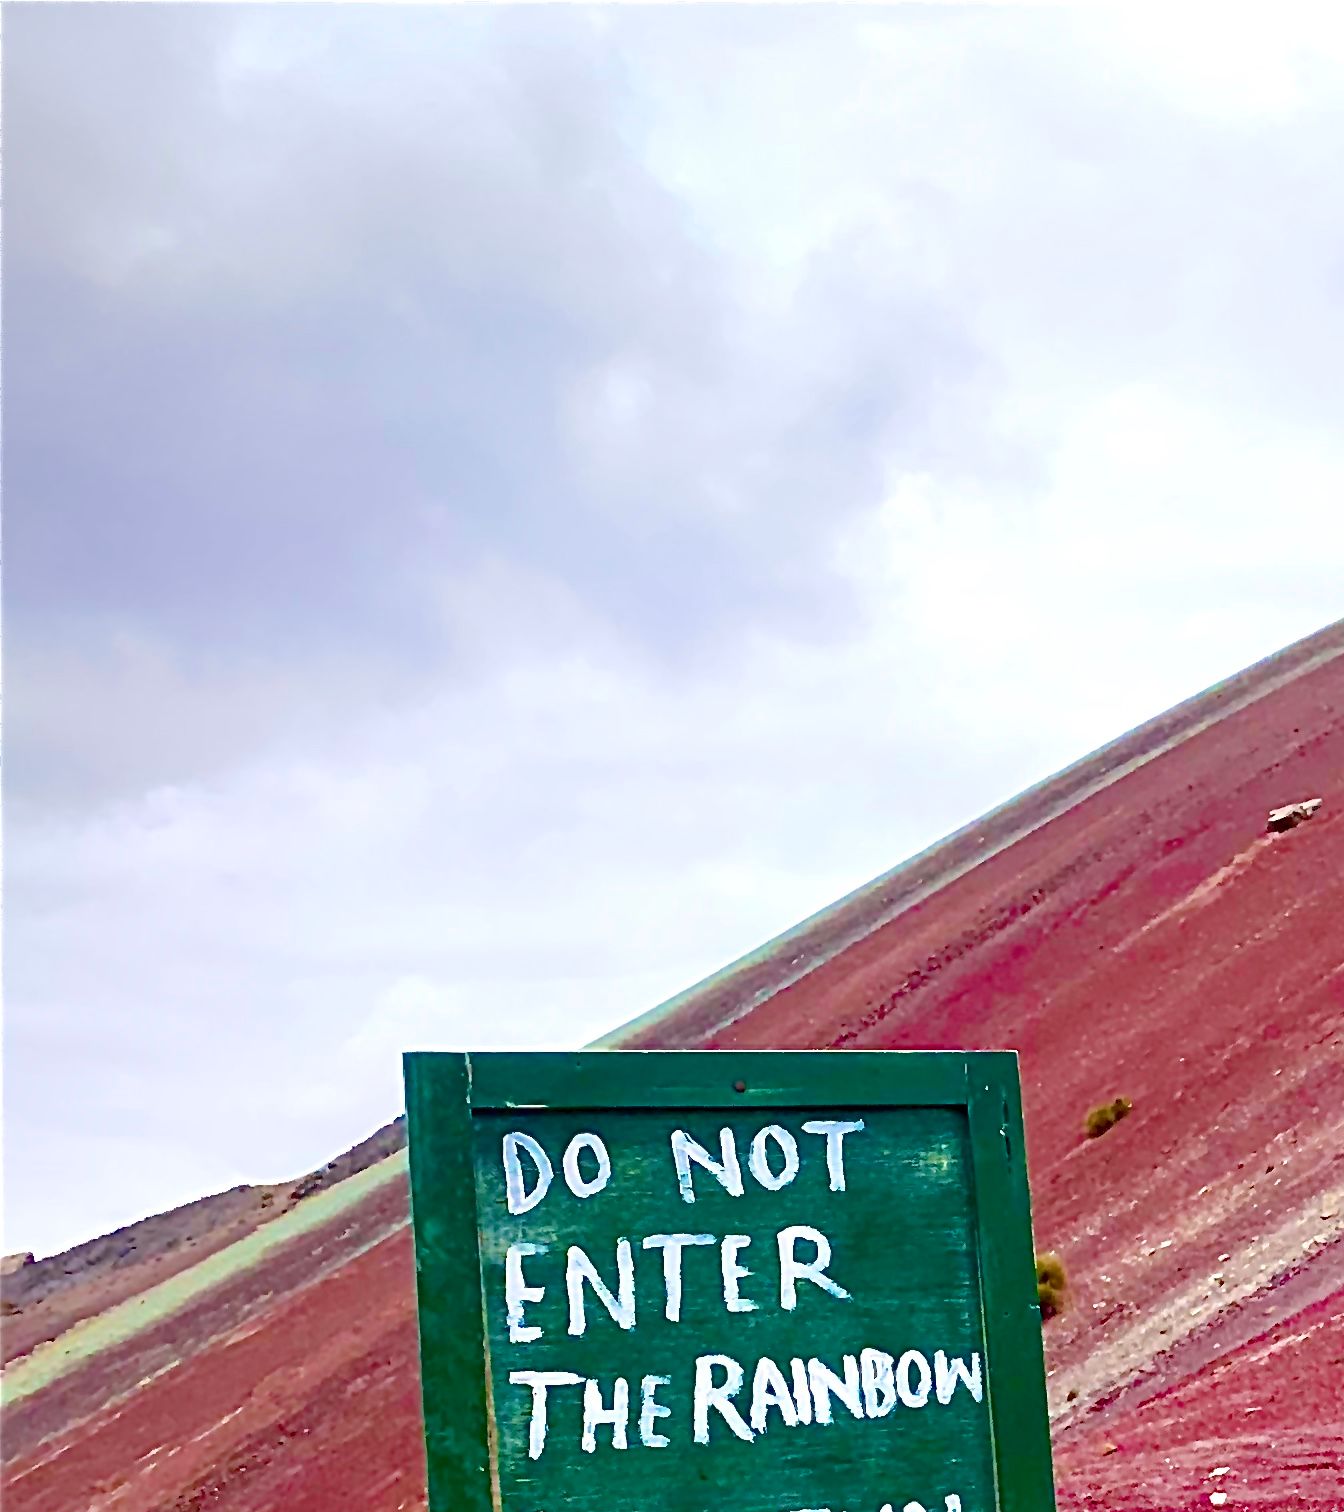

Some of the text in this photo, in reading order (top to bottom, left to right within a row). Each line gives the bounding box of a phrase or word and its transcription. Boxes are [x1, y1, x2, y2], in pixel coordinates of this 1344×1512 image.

[503, 1120, 864, 1215] DO NOT
[506, 1226, 851, 1342] ENTER
[510, 1348, 983, 1460] THE RAINBOW
